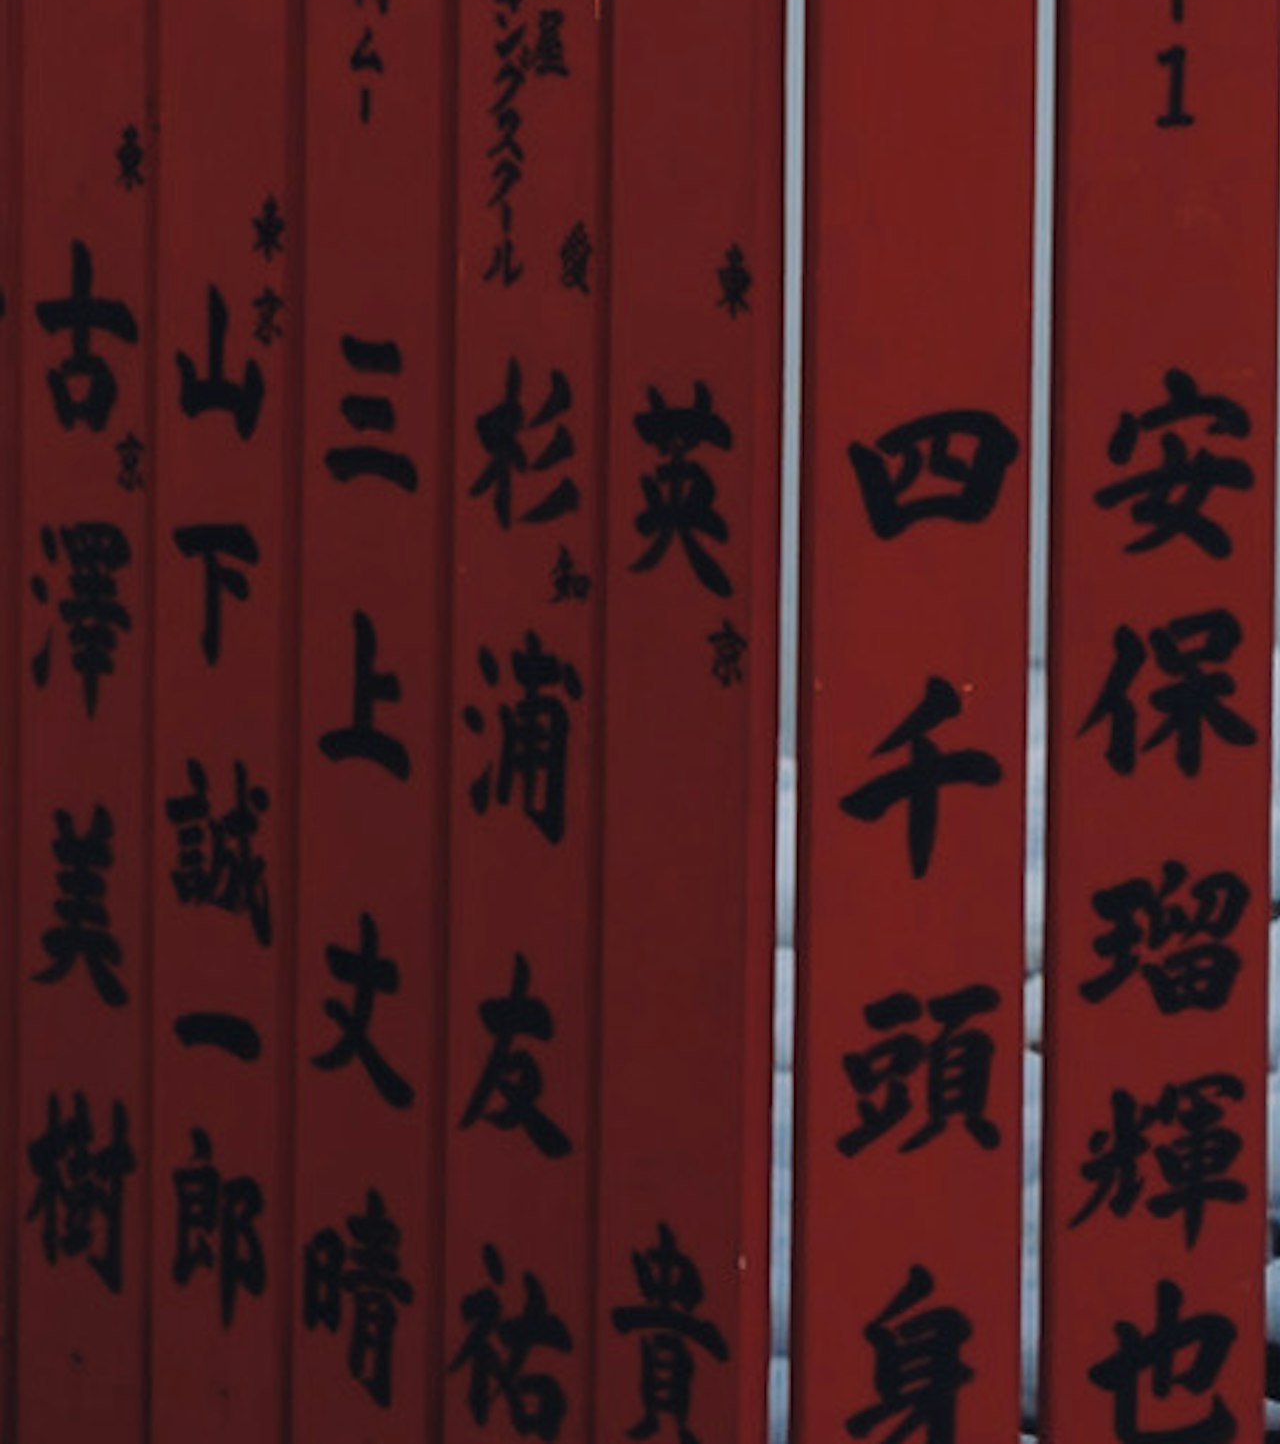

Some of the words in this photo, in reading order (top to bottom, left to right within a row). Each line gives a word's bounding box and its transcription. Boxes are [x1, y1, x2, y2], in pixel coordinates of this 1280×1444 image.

[27, 239, 139, 1295] 古澤美樹
[166, 284, 273, 1330] 山下誠一郎
[303, 334, 417, 1409] 三上丈晴
[447, 356, 583, 1443] 杉浦友祐
[838, 410, 1020, 1444] 四千頭身
[1067, 368, 1257, 1444] 安保瑠輝也
